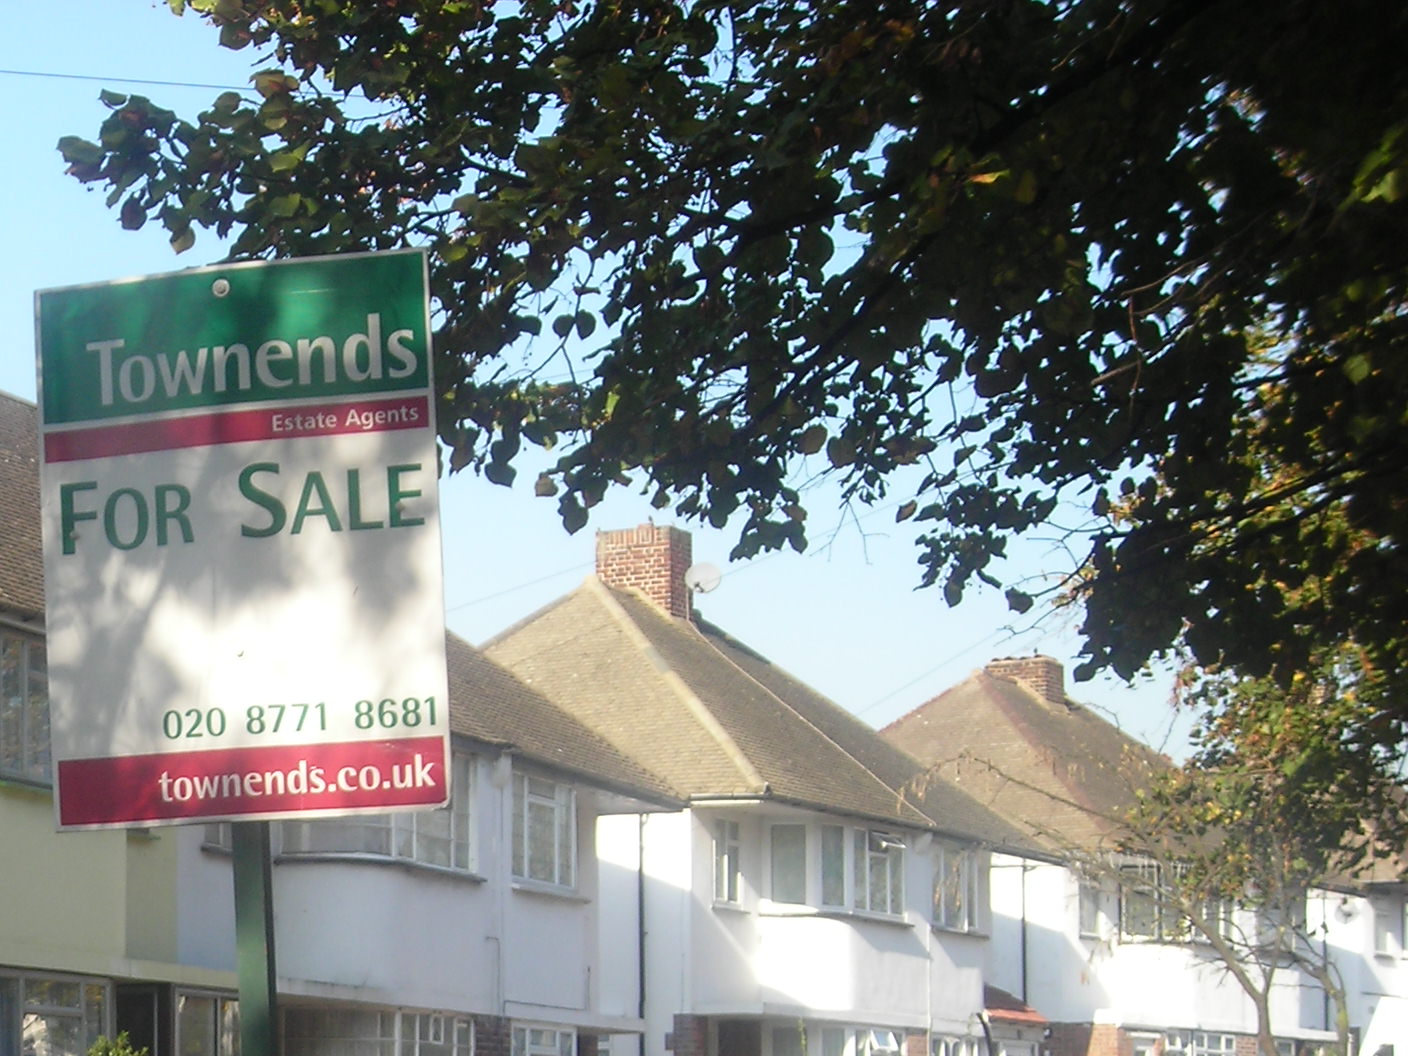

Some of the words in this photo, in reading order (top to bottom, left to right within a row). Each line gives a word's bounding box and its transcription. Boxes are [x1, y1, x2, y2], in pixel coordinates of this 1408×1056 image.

[86, 313, 418, 406] Townends
[271, 411, 338, 432] Estate
[345, 405, 419, 430] Agents
[60, 481, 195, 555] FOR
[238, 462, 425, 538] SALE
[162, 707, 226, 739] 020
[246, 702, 327, 735] 8771
[354, 696, 437, 729] 8681
[159, 754, 436, 802] townends.co.uk
